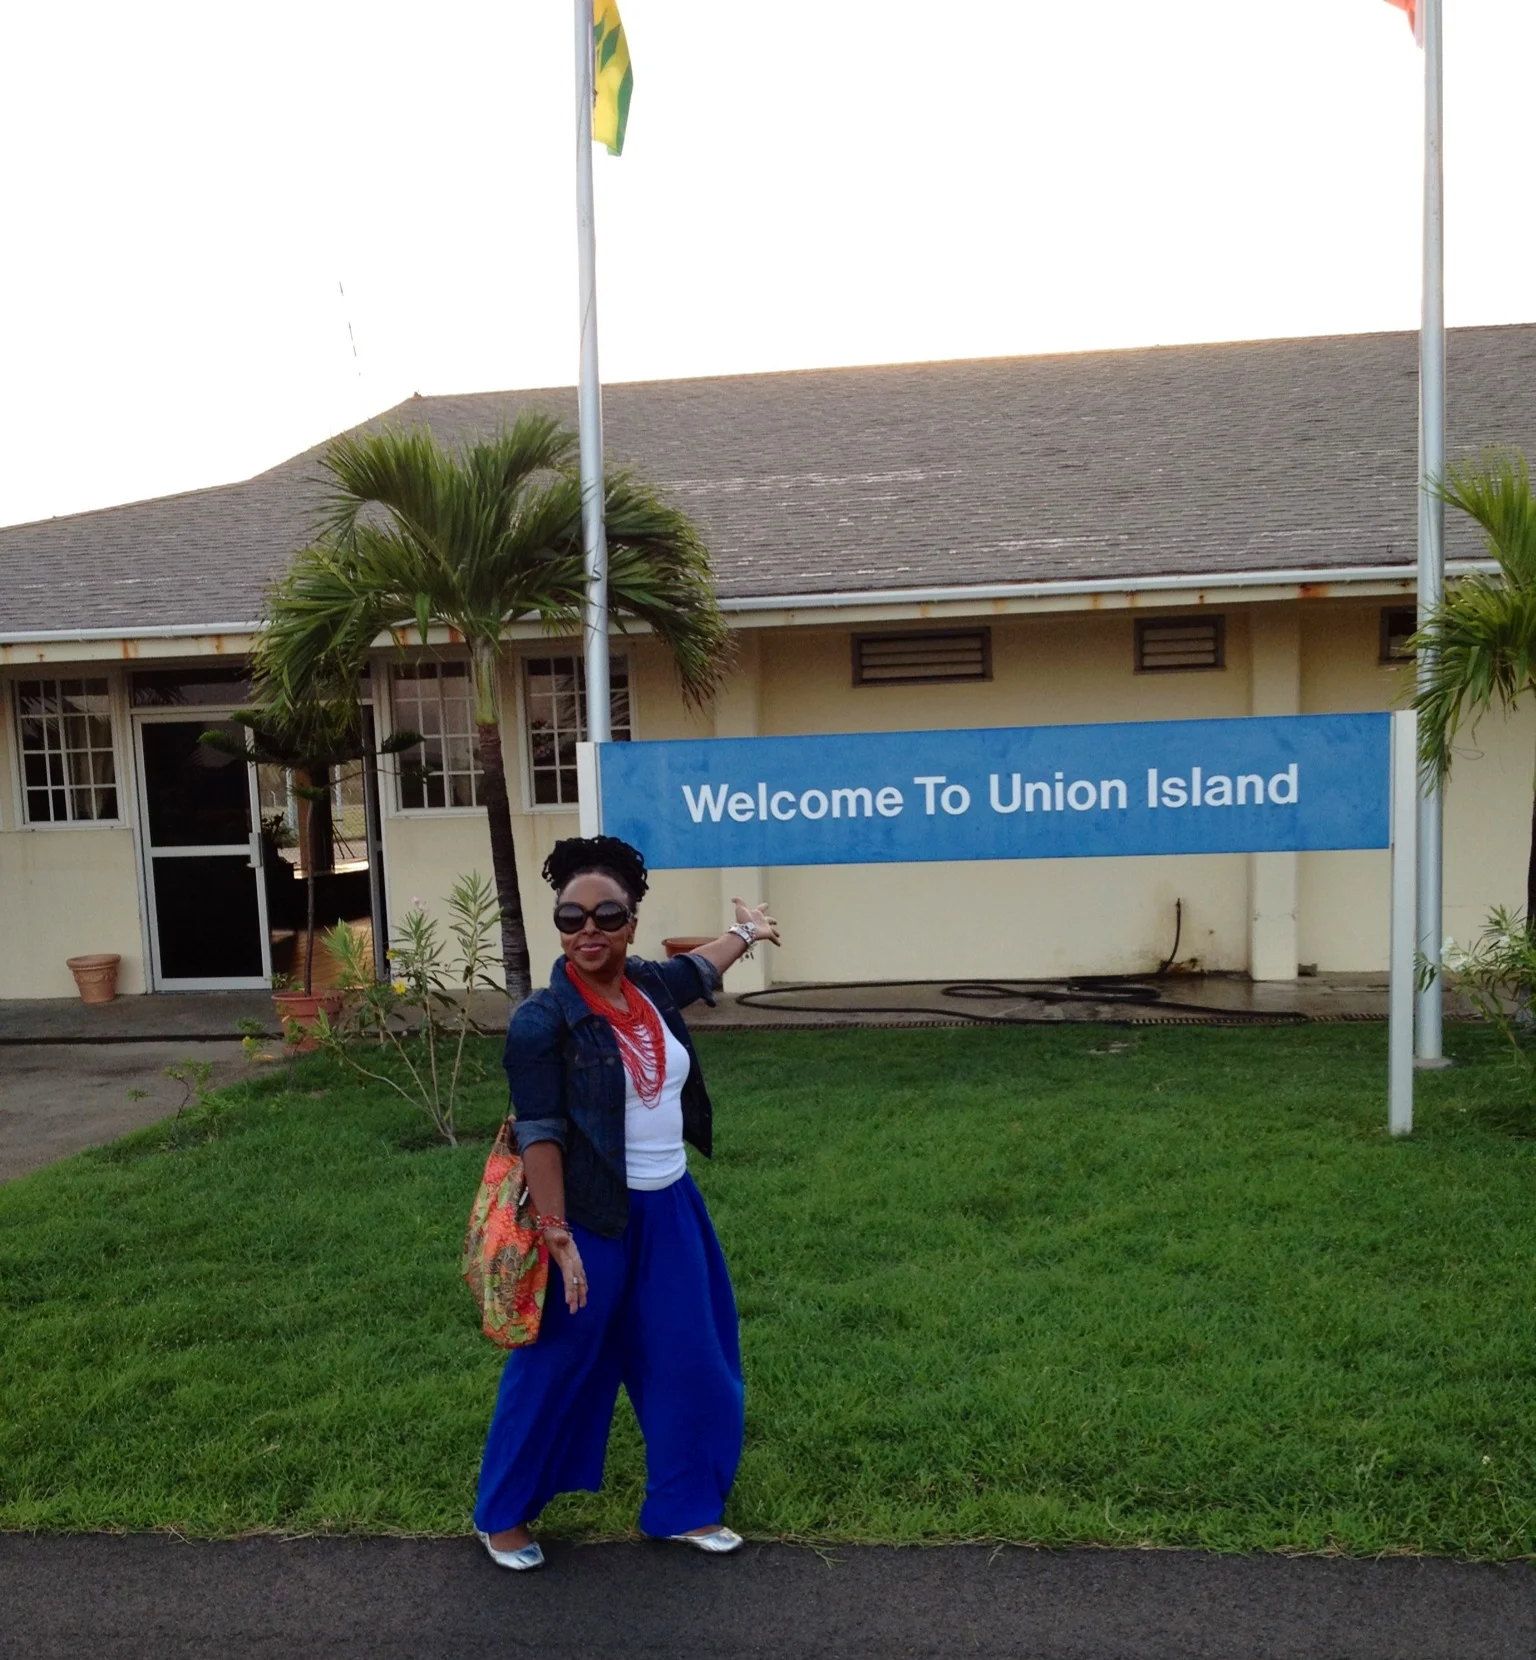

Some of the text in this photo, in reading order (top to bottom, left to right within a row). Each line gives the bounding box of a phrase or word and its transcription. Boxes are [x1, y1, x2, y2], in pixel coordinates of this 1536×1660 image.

[681, 763, 1299, 823] Welcome To Union Island
